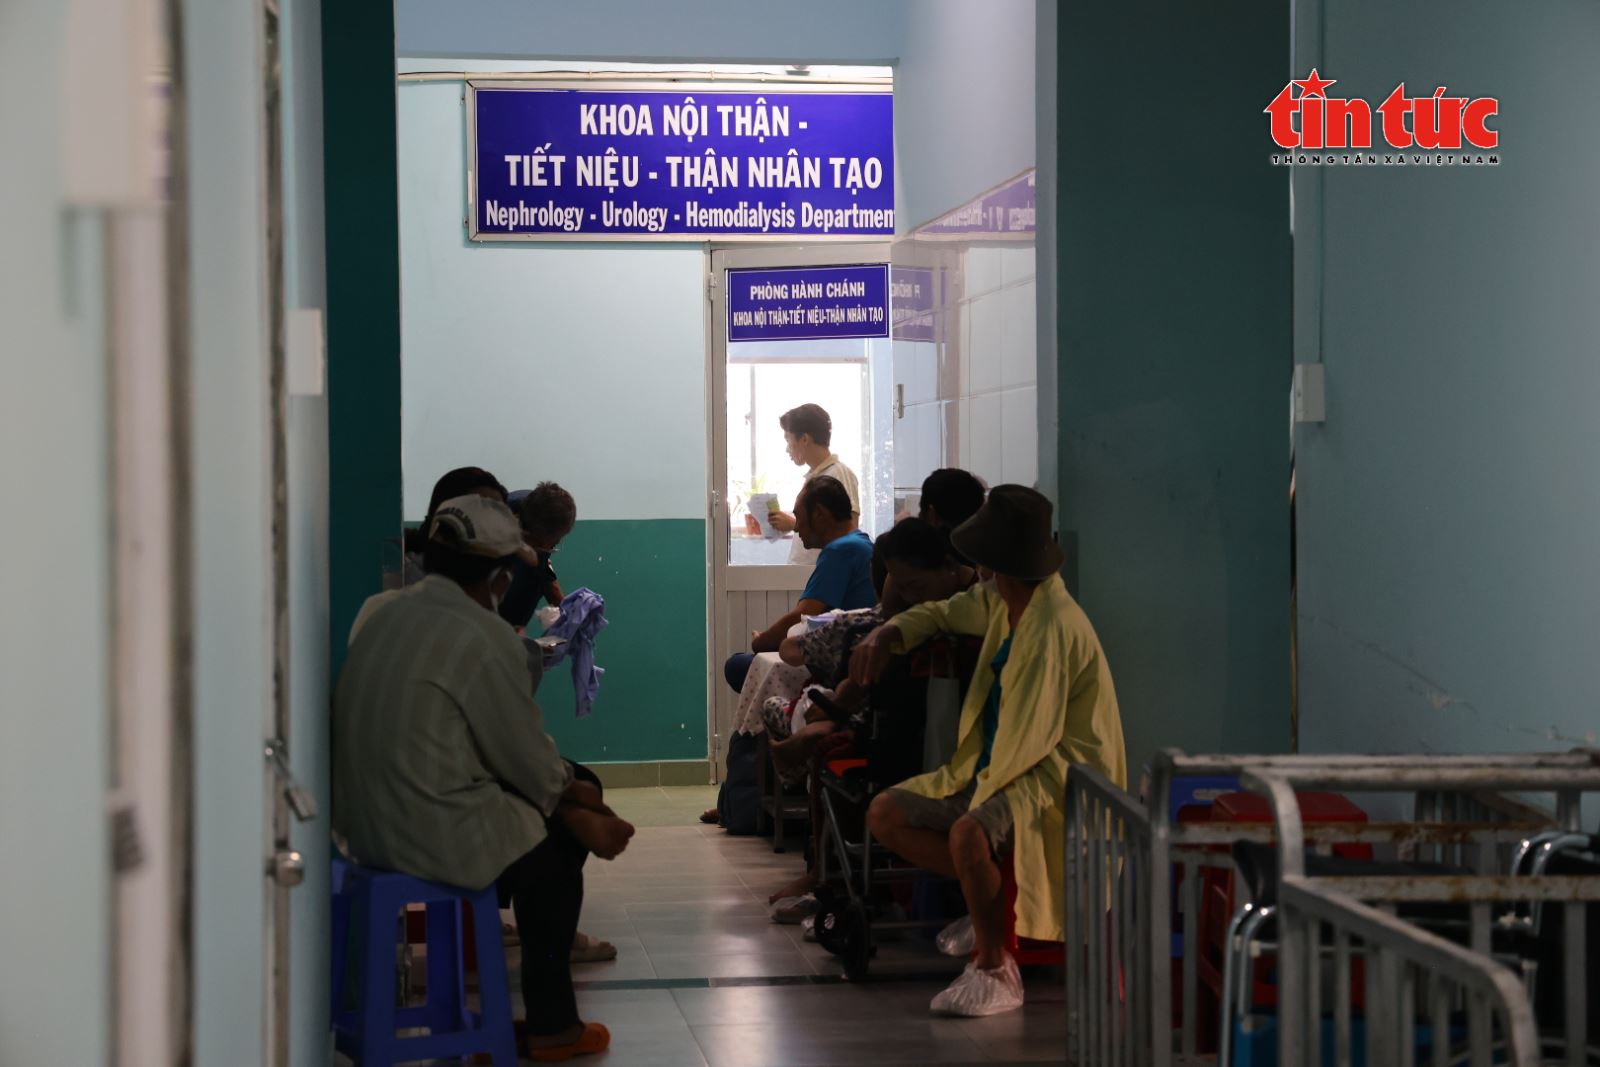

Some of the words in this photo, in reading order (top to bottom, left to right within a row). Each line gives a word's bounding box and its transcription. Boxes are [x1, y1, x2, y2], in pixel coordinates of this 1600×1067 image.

[580, 104, 653, 136] KHOA
[662, 97, 708, 143] NỘI
[716, 97, 790, 143] THẬN
[504, 142, 566, 187] TIẾT
[576, 147, 639, 193] NIỆU
[665, 148, 738, 194] THẬN
[748, 148, 821, 188] NHÂN
[828, 157, 883, 195] TẠO
[486, 200, 584, 231] Nephrology
[602, 201, 667, 232] Urology
[686, 201, 796, 233] Hemodialysis
[801, 202, 894, 232] Departmen
[750, 281, 788, 300] PHÒNG
[791, 280, 823, 299] HÀNH
[826, 278, 865, 297] CHÁNH
[733, 311, 753, 326] KHOA
[754, 309, 767, 328] NỘI
[847, 306, 867, 322] NHÂN
[869, 306, 884, 324] TẠO
